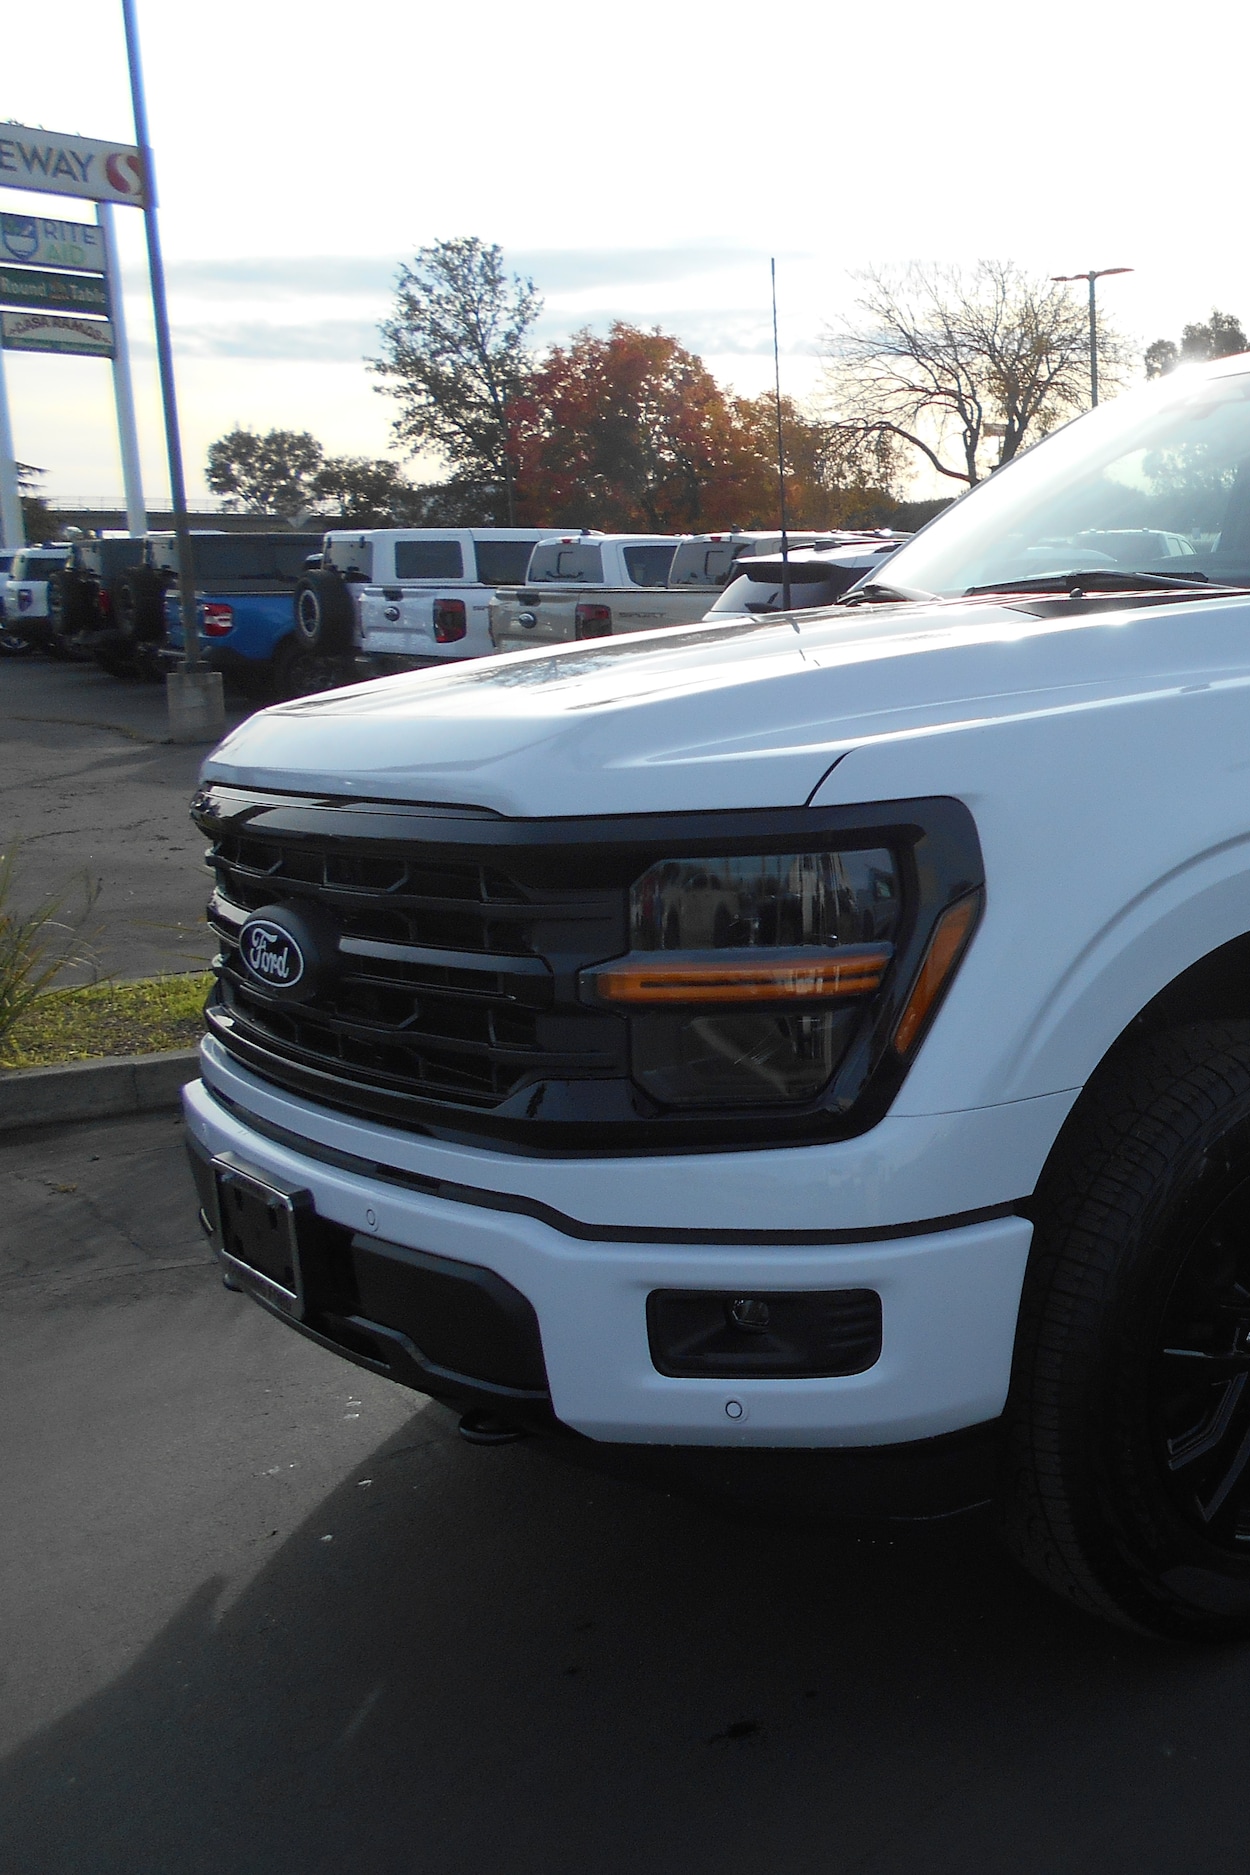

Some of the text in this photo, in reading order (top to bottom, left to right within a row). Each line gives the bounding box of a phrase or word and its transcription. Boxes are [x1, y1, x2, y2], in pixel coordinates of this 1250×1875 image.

[0, 138, 94, 182] EWAY
[42, 220, 98, 245] RITE
[46, 243, 85, 266] AID
[68, 284, 105, 303] Table
[15, 316, 50, 334] CASA
[250, 928, 289, 978] Ford
